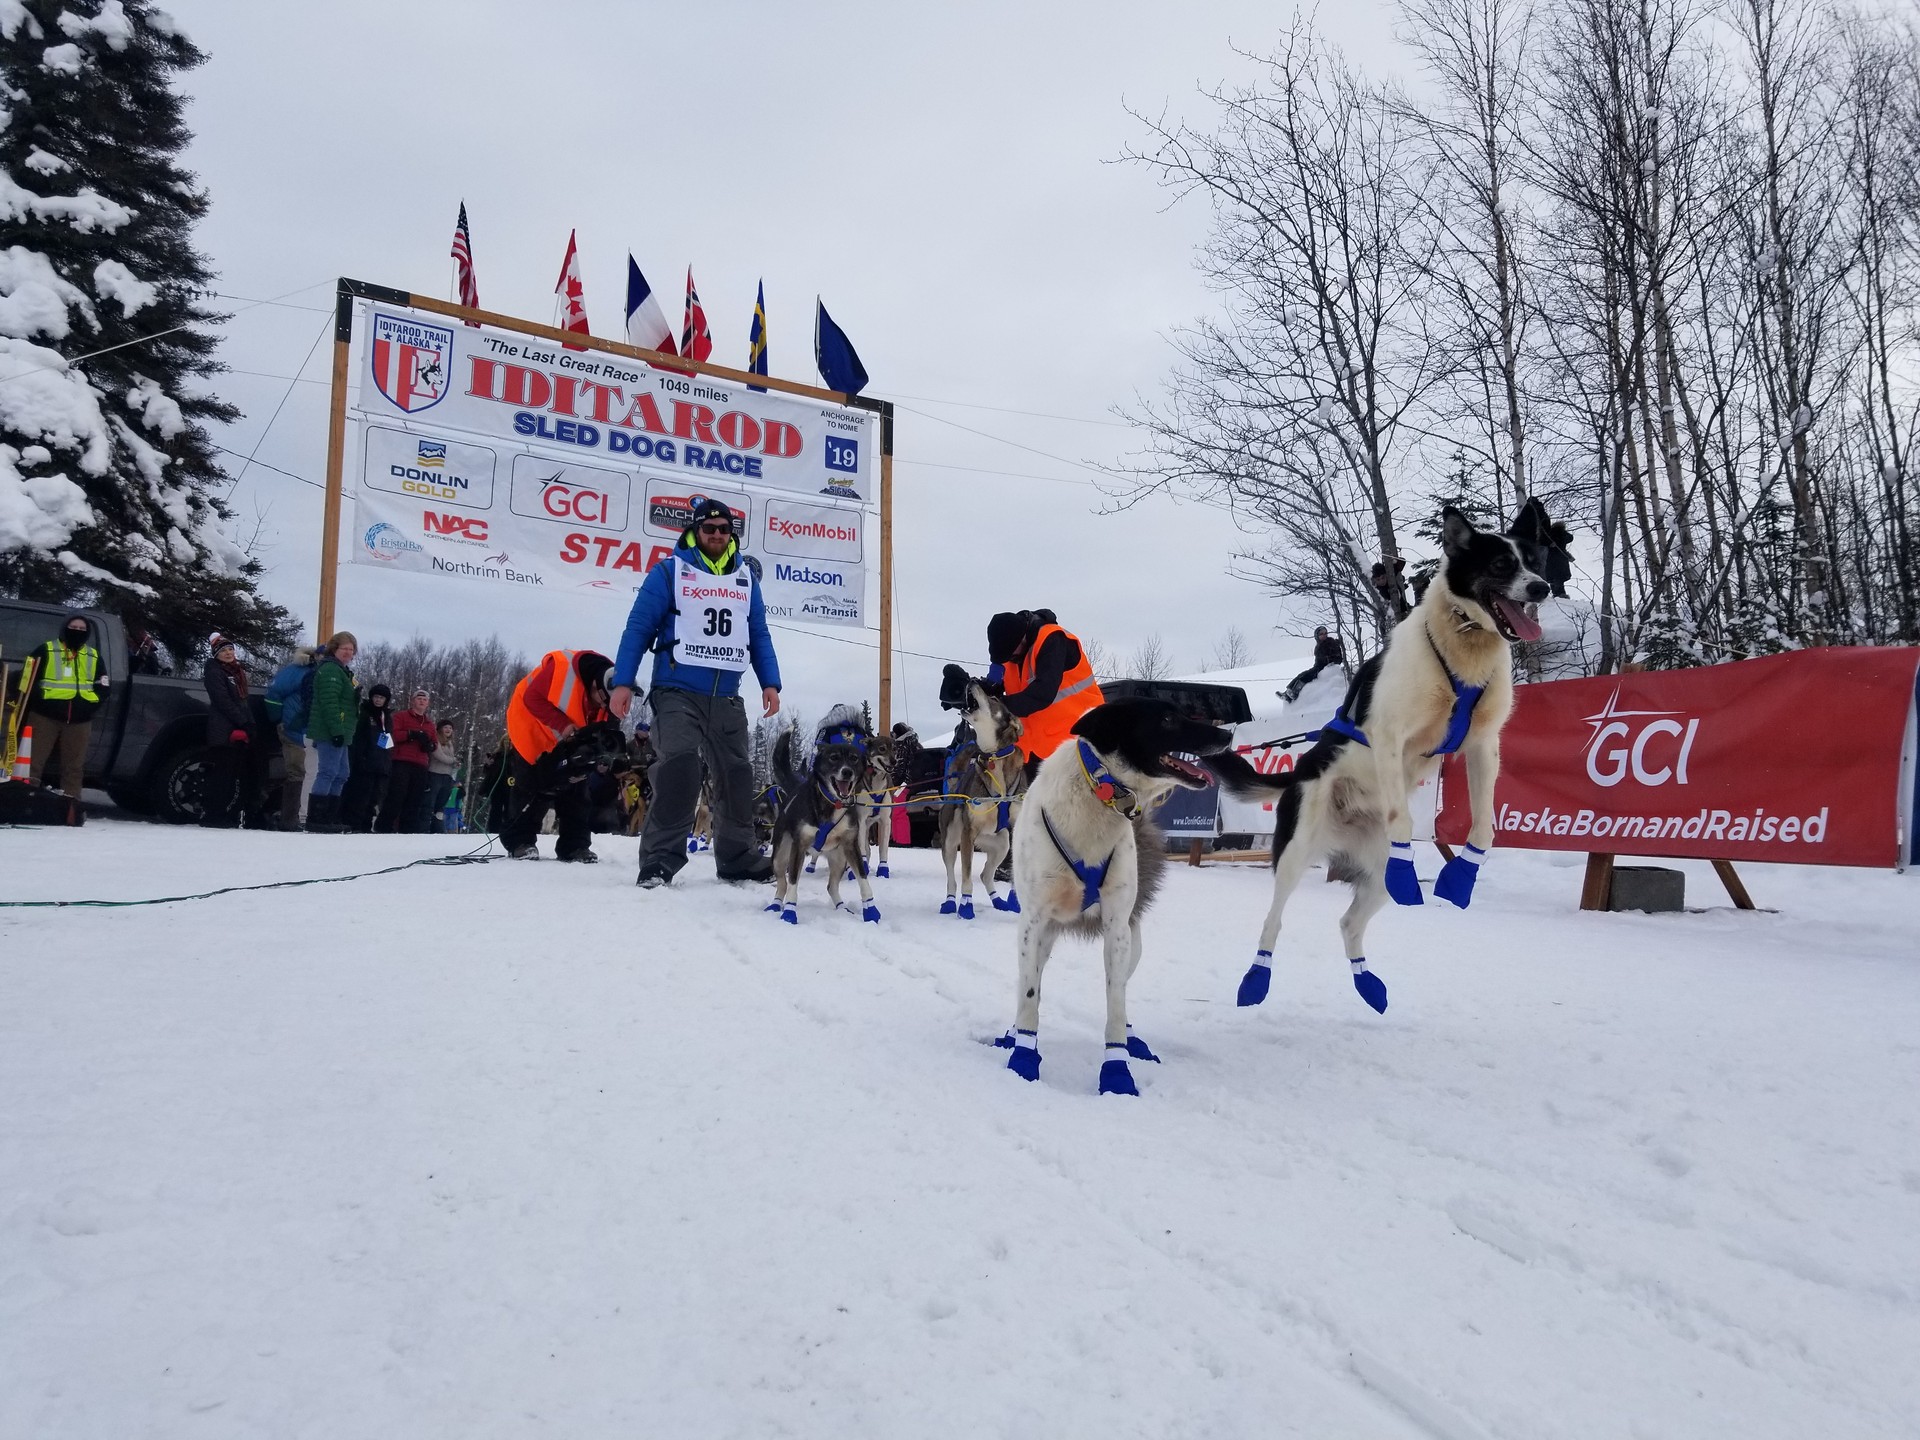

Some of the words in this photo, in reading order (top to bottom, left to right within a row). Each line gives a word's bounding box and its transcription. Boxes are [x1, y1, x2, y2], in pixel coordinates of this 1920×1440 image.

[380, 320, 421, 337] IDITAROD
[424, 329, 449, 344] TRAIL
[396, 334, 430, 349] ALASKA
[522, 350, 555, 365] Last
[559, 356, 601, 375] Great
[659, 377, 690, 395] 1049
[693, 385, 729, 403] miles
[464, 354, 803, 459] IDITAROD
[820, 410, 865, 425] ANCHORAGE
[827, 420, 836, 428] TO
[837, 423, 858, 433] NOME
[513, 411, 601, 448] SLED
[608, 428, 677, 463] DOG
[684, 443, 763, 479] RACE
[390, 464, 469, 490] DONLIN
[402, 481, 456, 499] GOLD
[543, 485, 608, 524] GCI
[424, 511, 489, 541] NAC
[768, 516, 856, 542] ExxonMobil
[381, 537, 408, 548] Bristol
[409, 540, 424, 551] Bay
[432, 556, 500, 579] Northrim
[505, 568, 544, 586] Bank
[775, 564, 843, 587] Matson
[682, 586, 748, 602] ExxonMobil
[703, 607, 733, 637] 36
[801, 604, 819, 613] Air
[820, 605, 858, 618] Transit
[685, 643, 733, 657] IDITAROD
[1586, 718, 1700, 787] GCI
